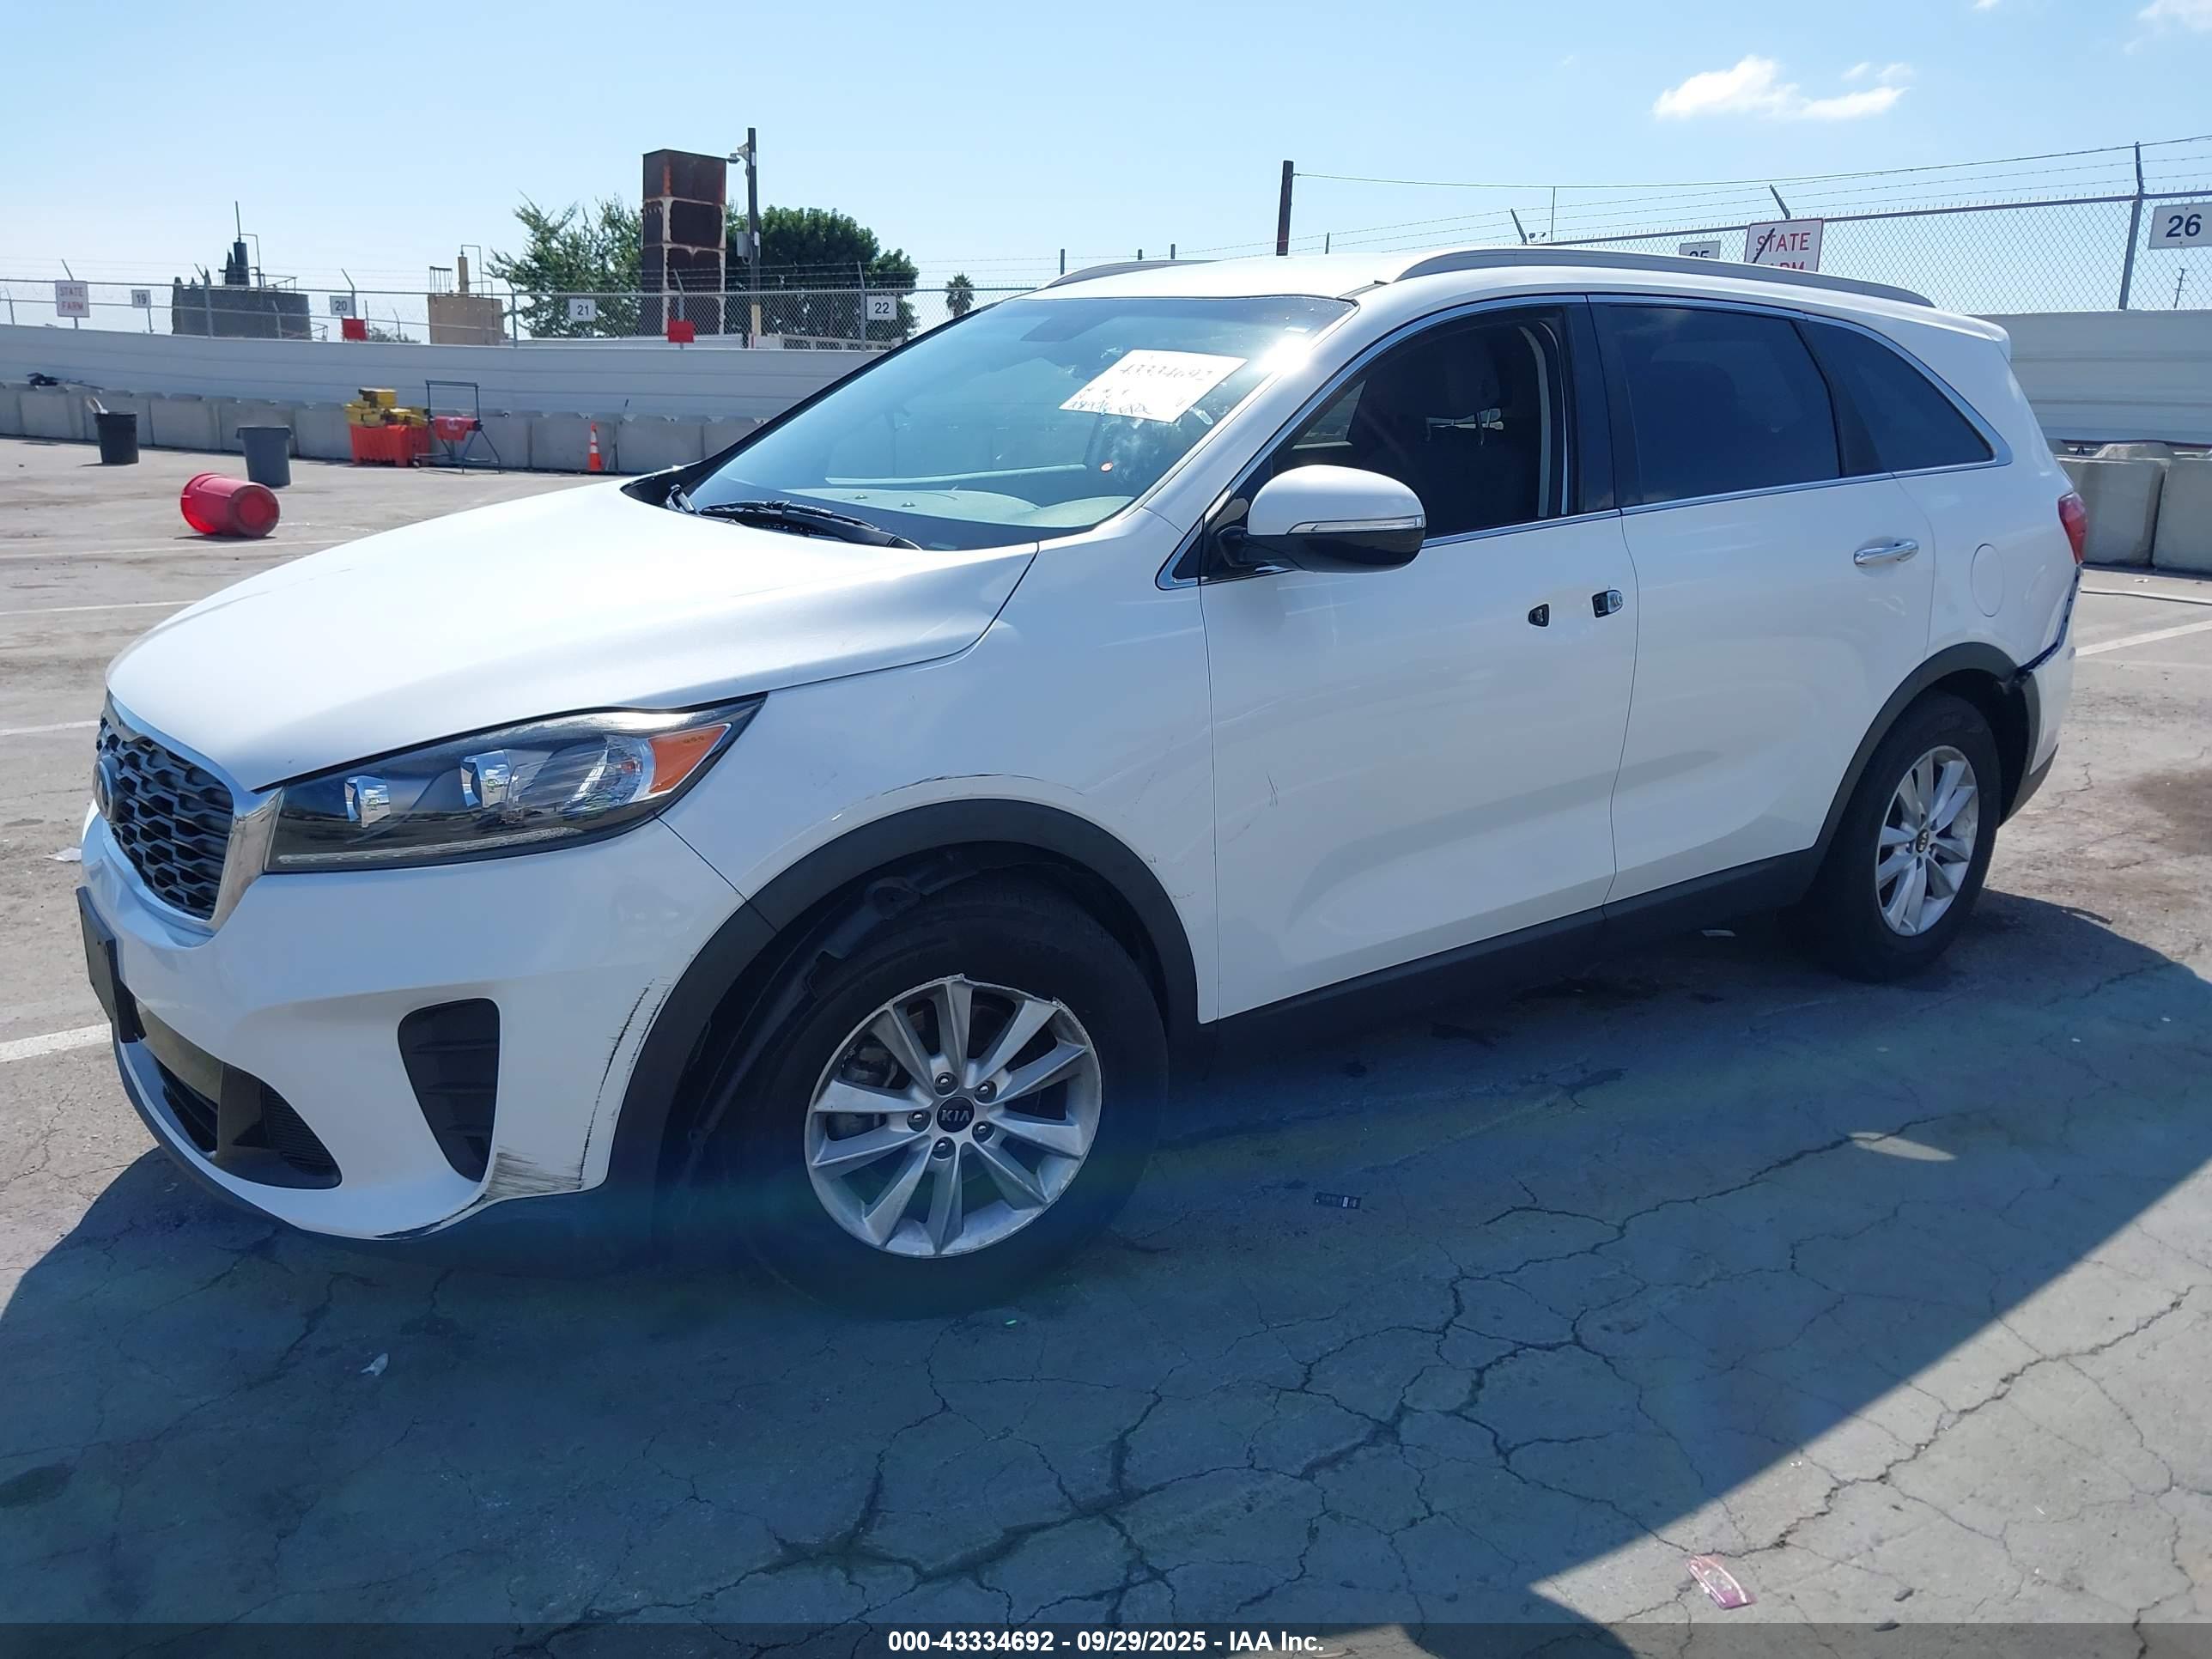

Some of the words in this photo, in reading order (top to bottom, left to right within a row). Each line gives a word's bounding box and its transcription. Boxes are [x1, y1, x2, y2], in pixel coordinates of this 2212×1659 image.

[2166, 213, 2203, 238] 26
[1756, 232, 1811, 252] STATE
[59, 287, 83, 296] STATE
[137, 294, 147, 304] 19
[61, 301, 83, 310] FARM
[335, 301, 348, 311] 20
[577, 305, 589, 315] 21
[874, 301, 890, 313] 22
[941, 1109, 970, 1121] KIA
